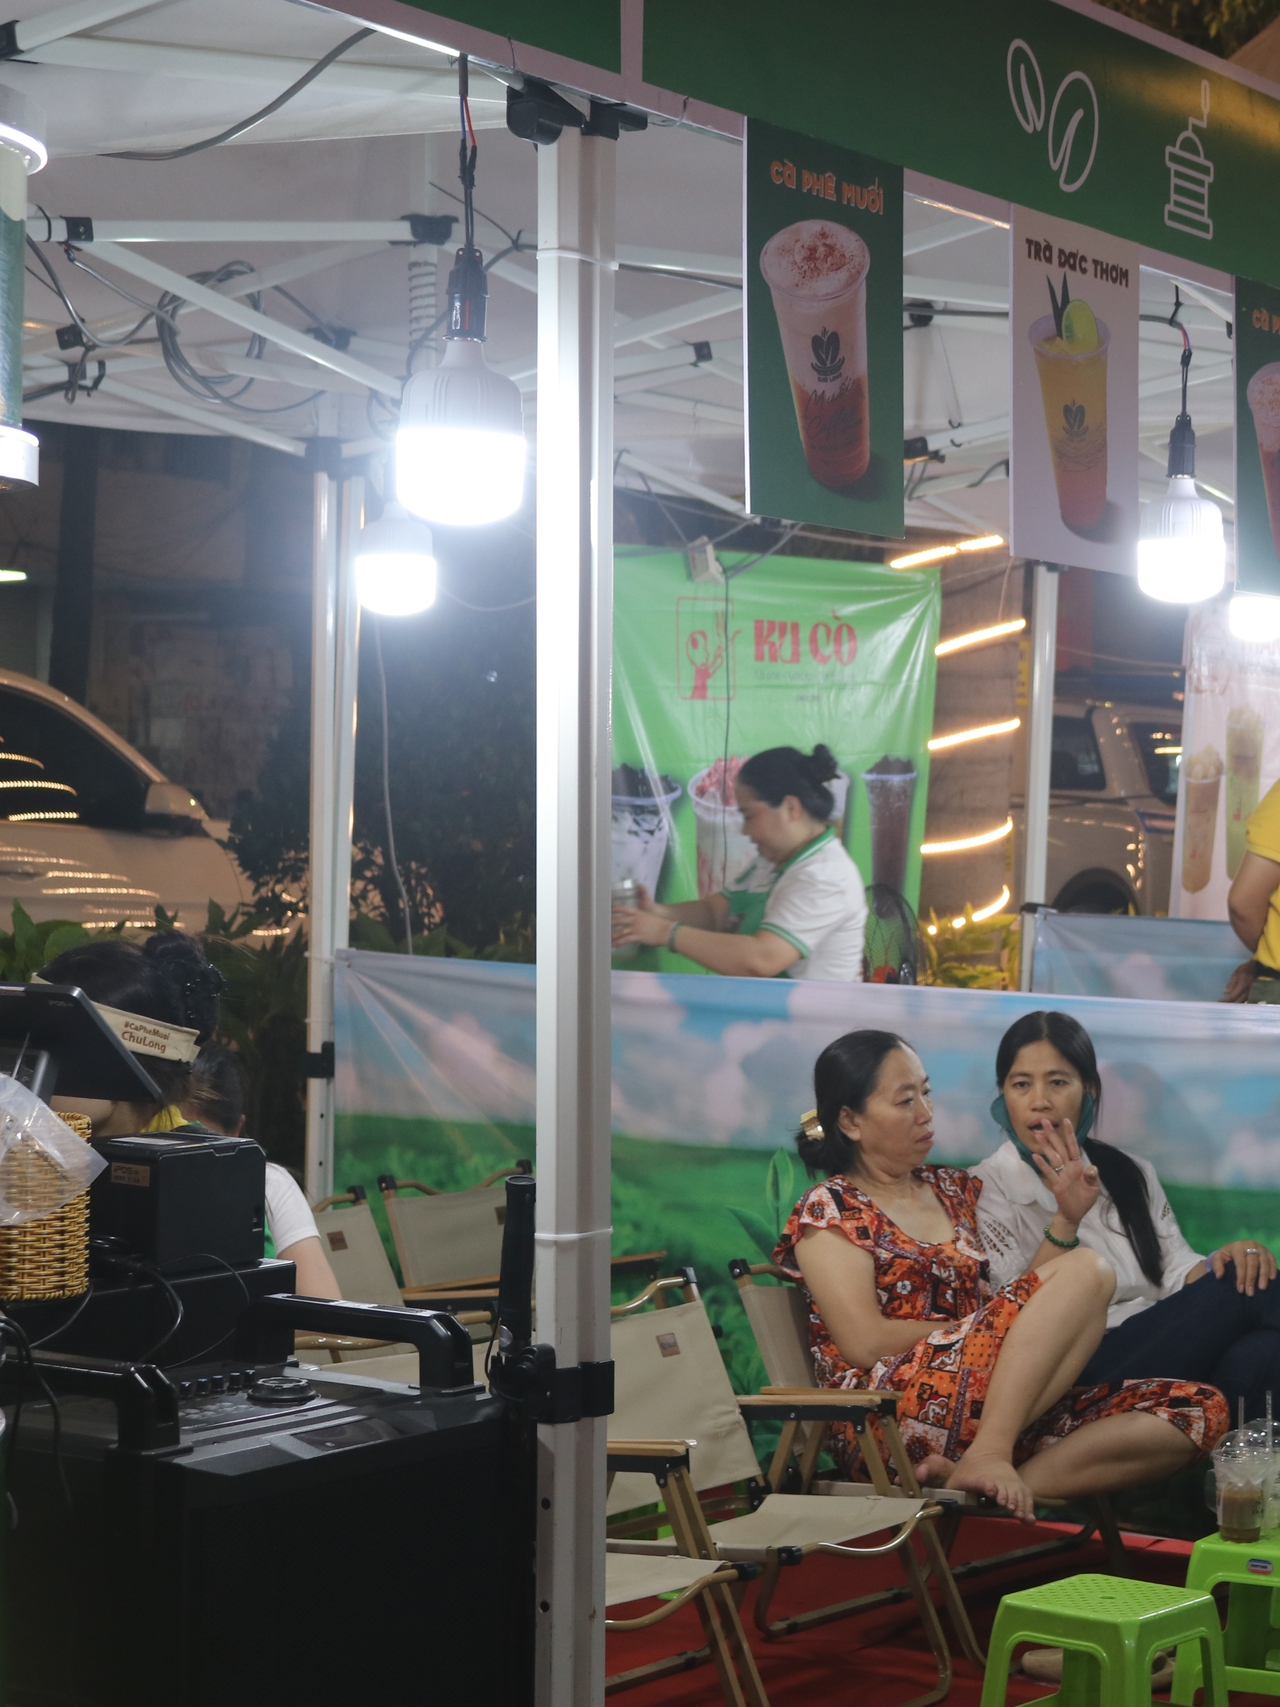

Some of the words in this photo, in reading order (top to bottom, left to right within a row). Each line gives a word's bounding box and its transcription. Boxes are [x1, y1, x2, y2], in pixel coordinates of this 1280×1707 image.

[771, 158, 796, 190] CÀ
[802, 169, 836, 201] PHÊ
[842, 177, 883, 215] MUỐI
[1026, 238, 1053, 265] TRÀ
[1092, 258, 1129, 288] THƠM
[1252, 308, 1269, 331] CÀ
[809, 607, 858, 666] CÒ
[121, 1031, 167, 1054] ChuLong
[124, 1020, 171, 1041] #CaPheMuoi
